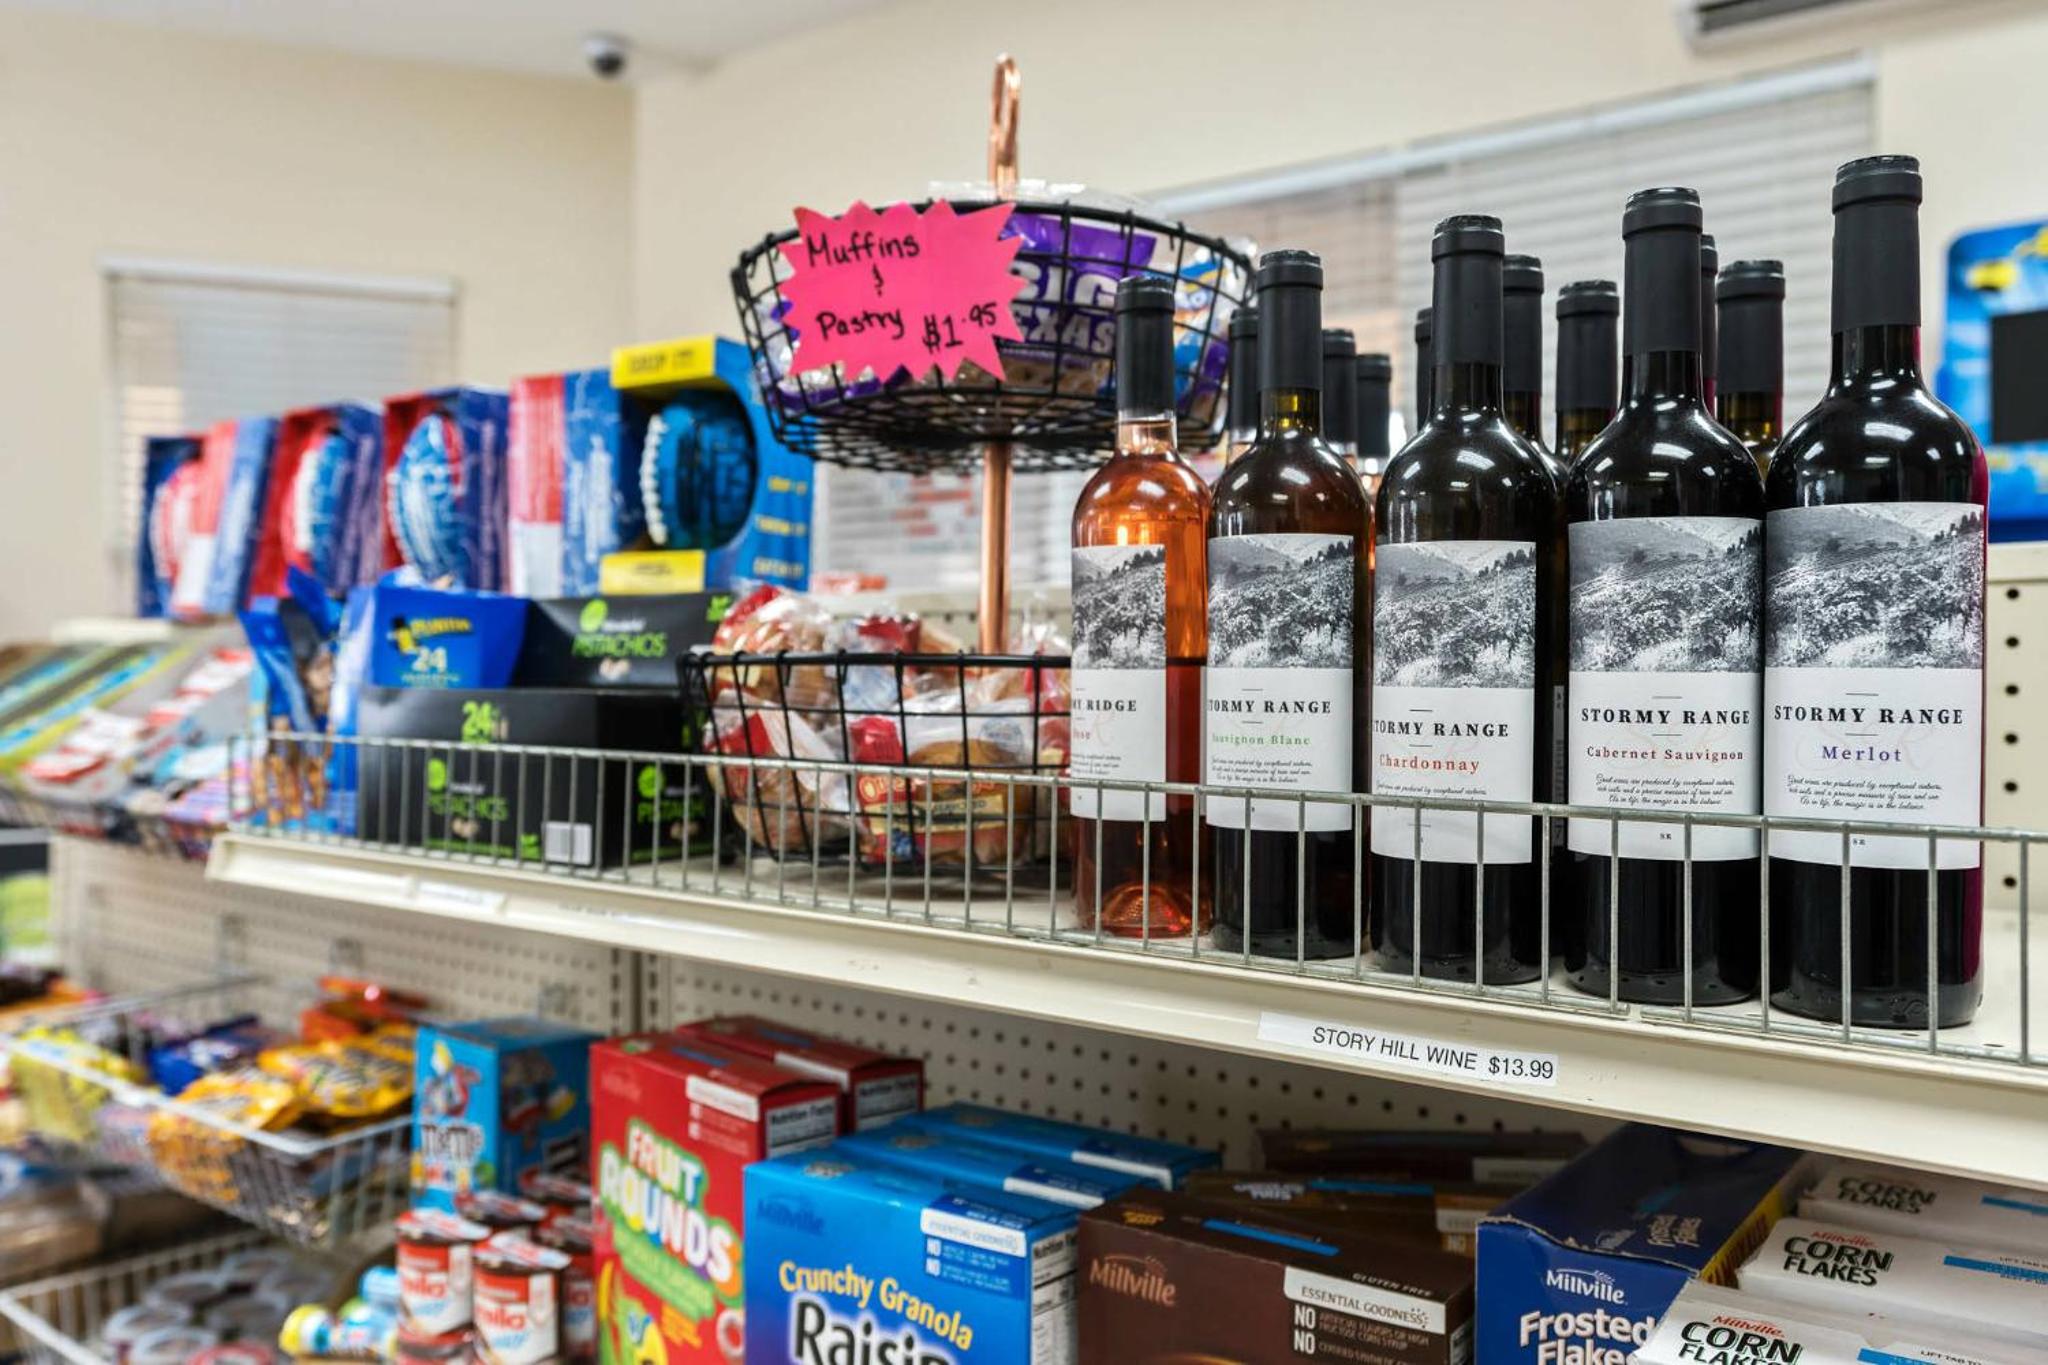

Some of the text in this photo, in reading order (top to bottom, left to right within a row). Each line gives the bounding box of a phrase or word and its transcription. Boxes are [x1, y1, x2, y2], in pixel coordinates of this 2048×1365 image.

[807, 232, 921, 267] Muffins
[816, 308, 905, 340] Pastry
[1011, 302, 1114, 353] EXAS
[413, 646, 447, 673] 24
[1087, 700, 1136, 712] RIDGE
[1208, 699, 1331, 714] TORMY RANGE
[1581, 707, 1751, 725] STORMY RANGE
[1774, 705, 1964, 725] STORMY RANGE
[1271, 735, 1311, 745] Blanc
[1374, 720, 1509, 737] TORMY RANGE
[1379, 754, 1480, 775] Chardonnay
[1586, 745, 1743, 763] Cabernet Sauvignon
[1822, 746, 1903, 762] Merlot
[1312, 1026, 1554, 1079] STORY HILL WINE $13.99
[628, 1124, 702, 1203] FRUIT
[1837, 1189, 1922, 1215] FLAKES
[1838, 1176, 1938, 1206] CORN
[600, 1147, 733, 1284] ROUNDS
[1811, 1229, 1879, 1248] Millville
[1783, 1235, 1896, 1273] CORN
[1089, 1257, 1177, 1308] Millville
[1352, 1272, 1433, 1297] GLUTEN FREE
[1782, 1255, 1878, 1287] FLAKES
[1546, 1268, 1626, 1306] Millville
[779, 1259, 874, 1309] Crunchy
[879, 1277, 974, 1350] Granola
[1294, 1305, 1316, 1330] NO
[1301, 1286, 1425, 1325] ESSENTIAL GOODNESS
[795, 1300, 951, 1365] Raisi
[1520, 1308, 1656, 1348] Frosted
[1711, 1315, 1785, 1338] Millville
[1293, 1330, 1316, 1355] NO
[1537, 1338, 1637, 1365] Flake
[1678, 1343, 1783, 1365] FLAK
[1680, 1321, 1804, 1365] CORN
[1921, 1350, 1942, 1360] LIFT
[1945, 1354, 1966, 1365] TAB
